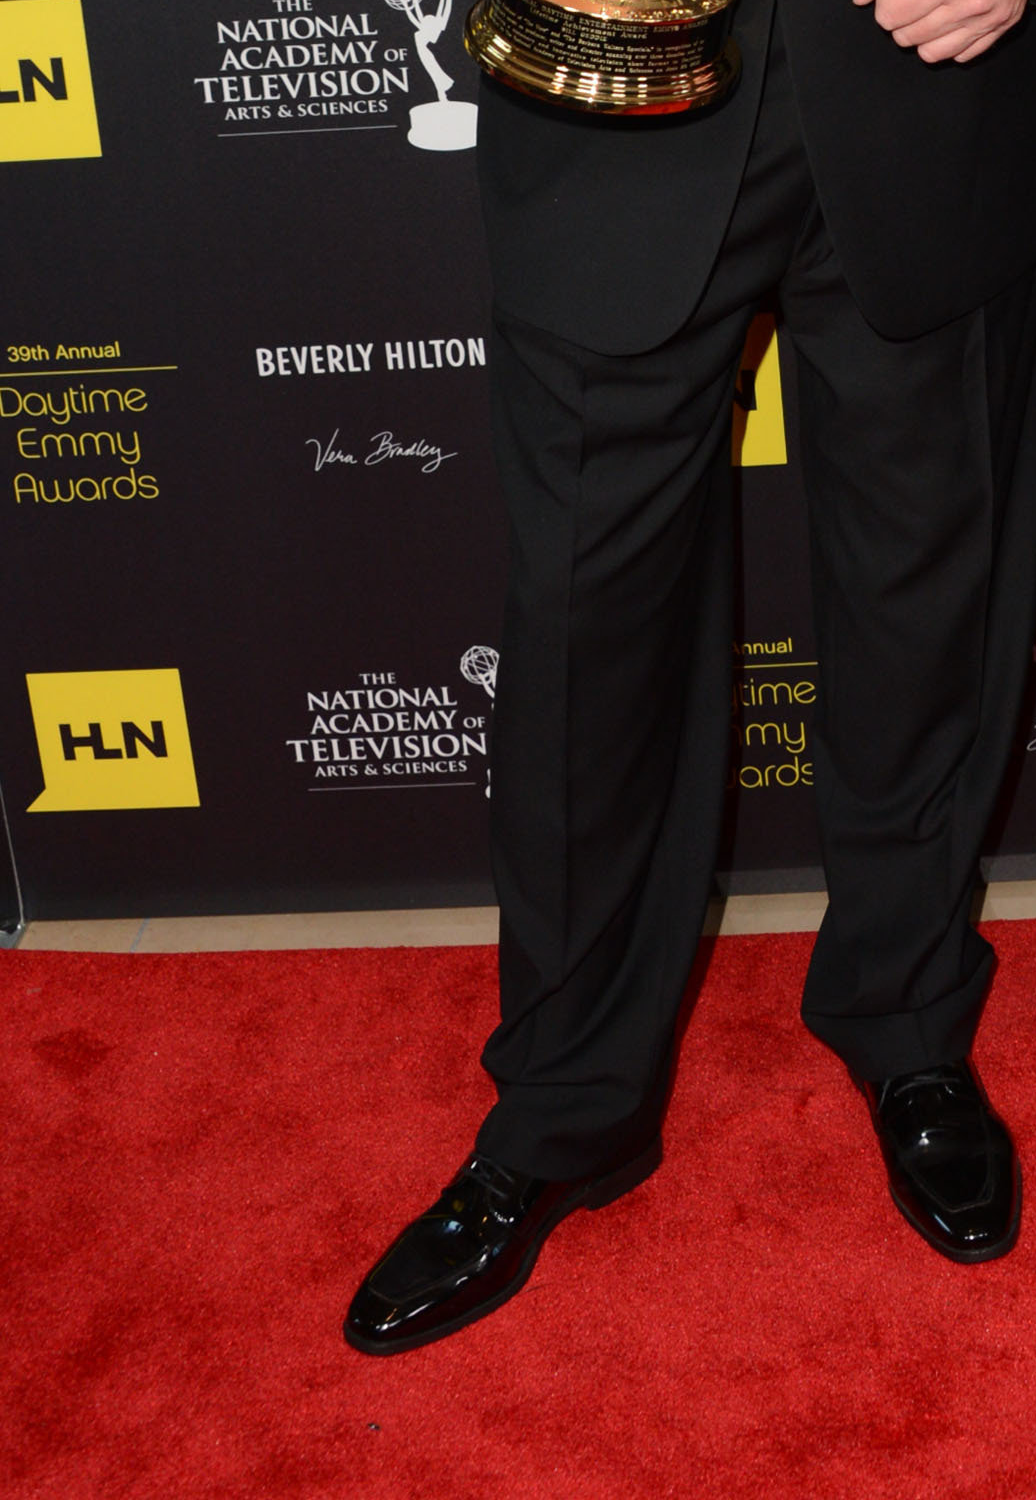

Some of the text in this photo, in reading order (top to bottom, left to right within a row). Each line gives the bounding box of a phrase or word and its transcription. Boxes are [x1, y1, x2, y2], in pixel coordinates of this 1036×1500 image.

[216, 13, 378, 43] NATIONAL
[219, 41, 408, 71] ACADEMY OF
[194, 67, 409, 104] TELEVISION
[225, 99, 388, 121] ARTS & SCIENCES
[7, 341, 120, 362] 39th Annual
[256, 337, 486, 377] BEVERLY HILTON
[0, 384, 148, 425] Daytime
[17, 428, 141, 465] Emmy
[305, 428, 457, 473] Vera Bradley
[14, 468, 160, 504] Awards
[358, 672, 397, 686] THE
[306, 686, 457, 712] NATIONAL
[311, 709, 486, 735] ACADEMY OF
[58, 720, 168, 761] HLN
[286, 732, 487, 763] TELEVISION
[315, 759, 469, 778] ARTS & SCIENCES
